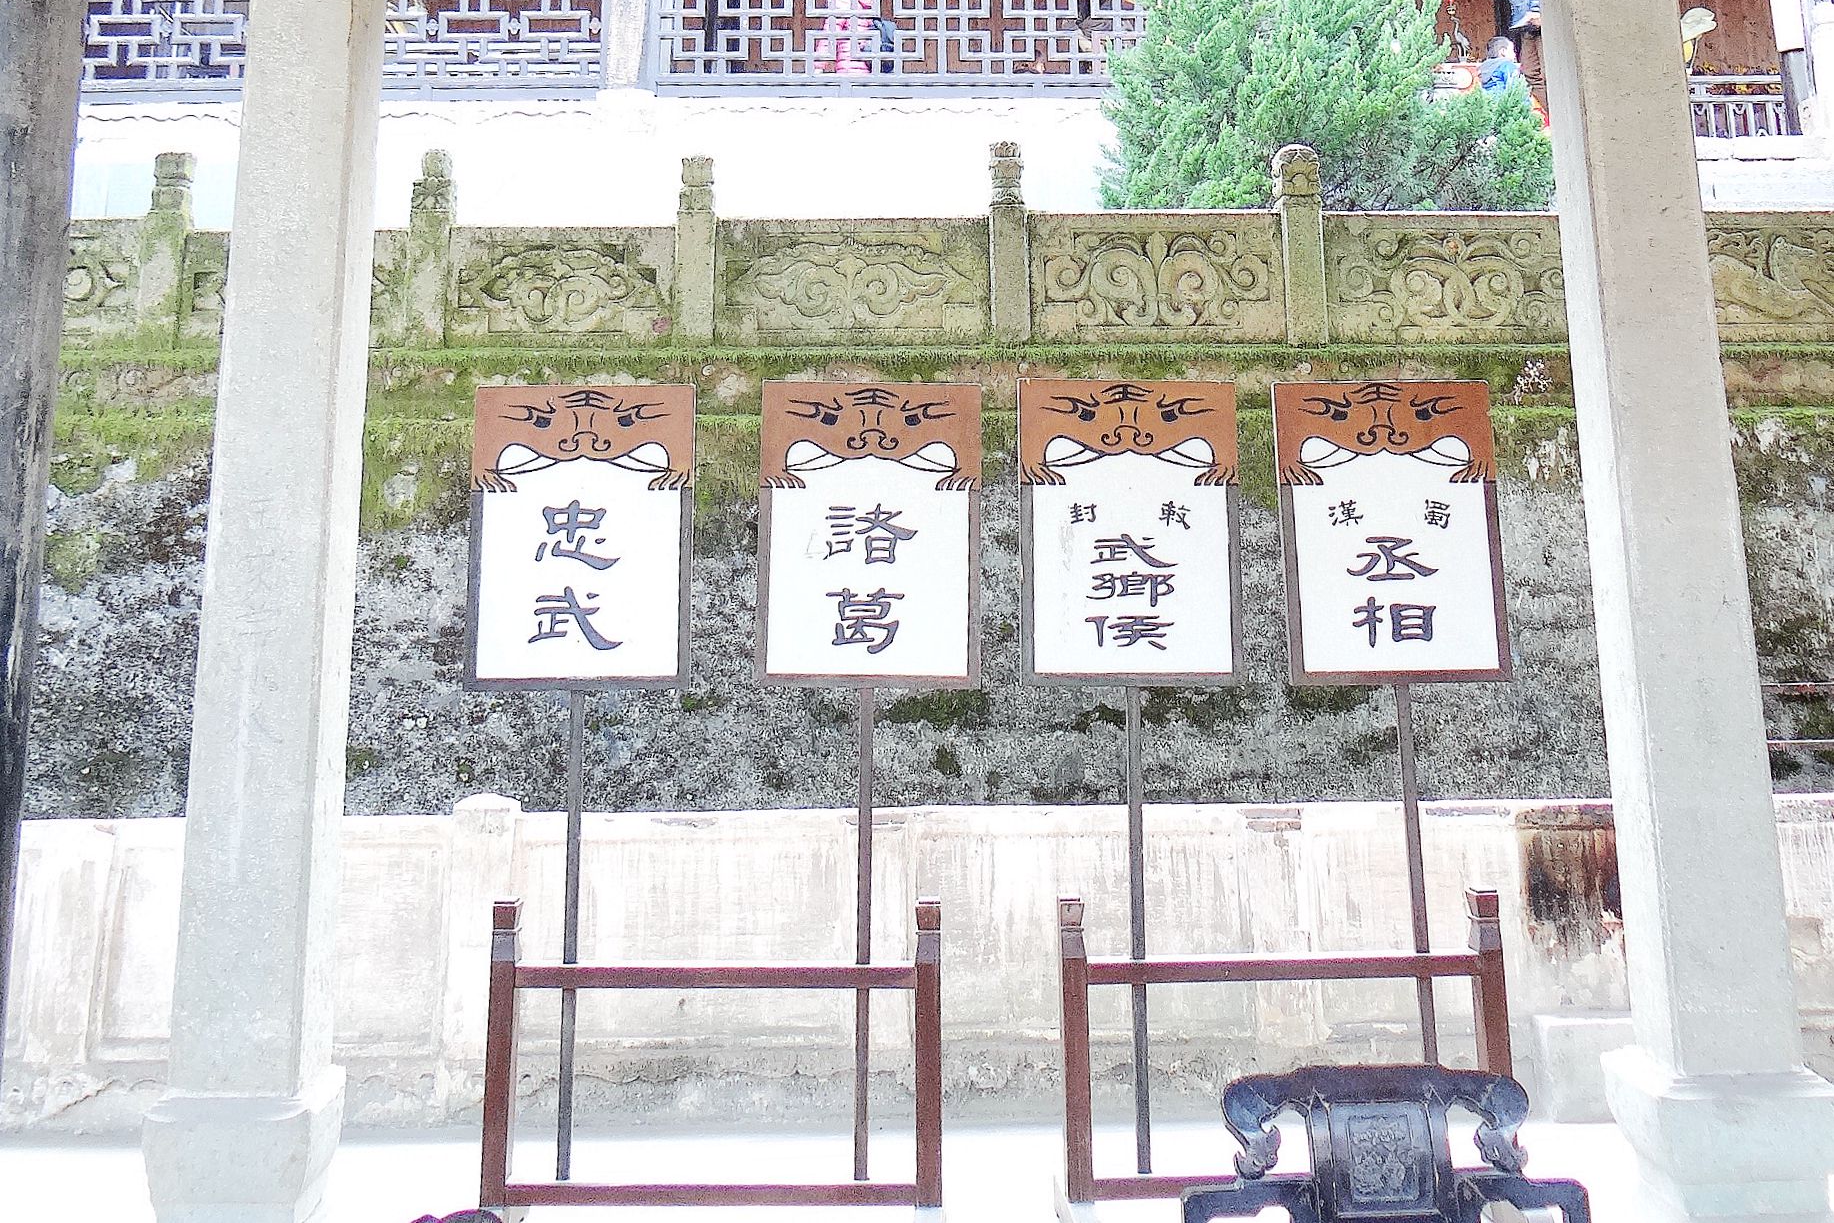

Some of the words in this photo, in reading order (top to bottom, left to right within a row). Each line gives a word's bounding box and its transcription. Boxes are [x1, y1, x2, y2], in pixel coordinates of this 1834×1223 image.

[1329, 499, 1450, 529] 蜀漢
[528, 500, 623, 650] 忠武
[826, 503, 918, 654] 諸葛
[1085, 534, 1178, 650] 武鄉侯
[1347, 537, 1439, 648] 丞相
